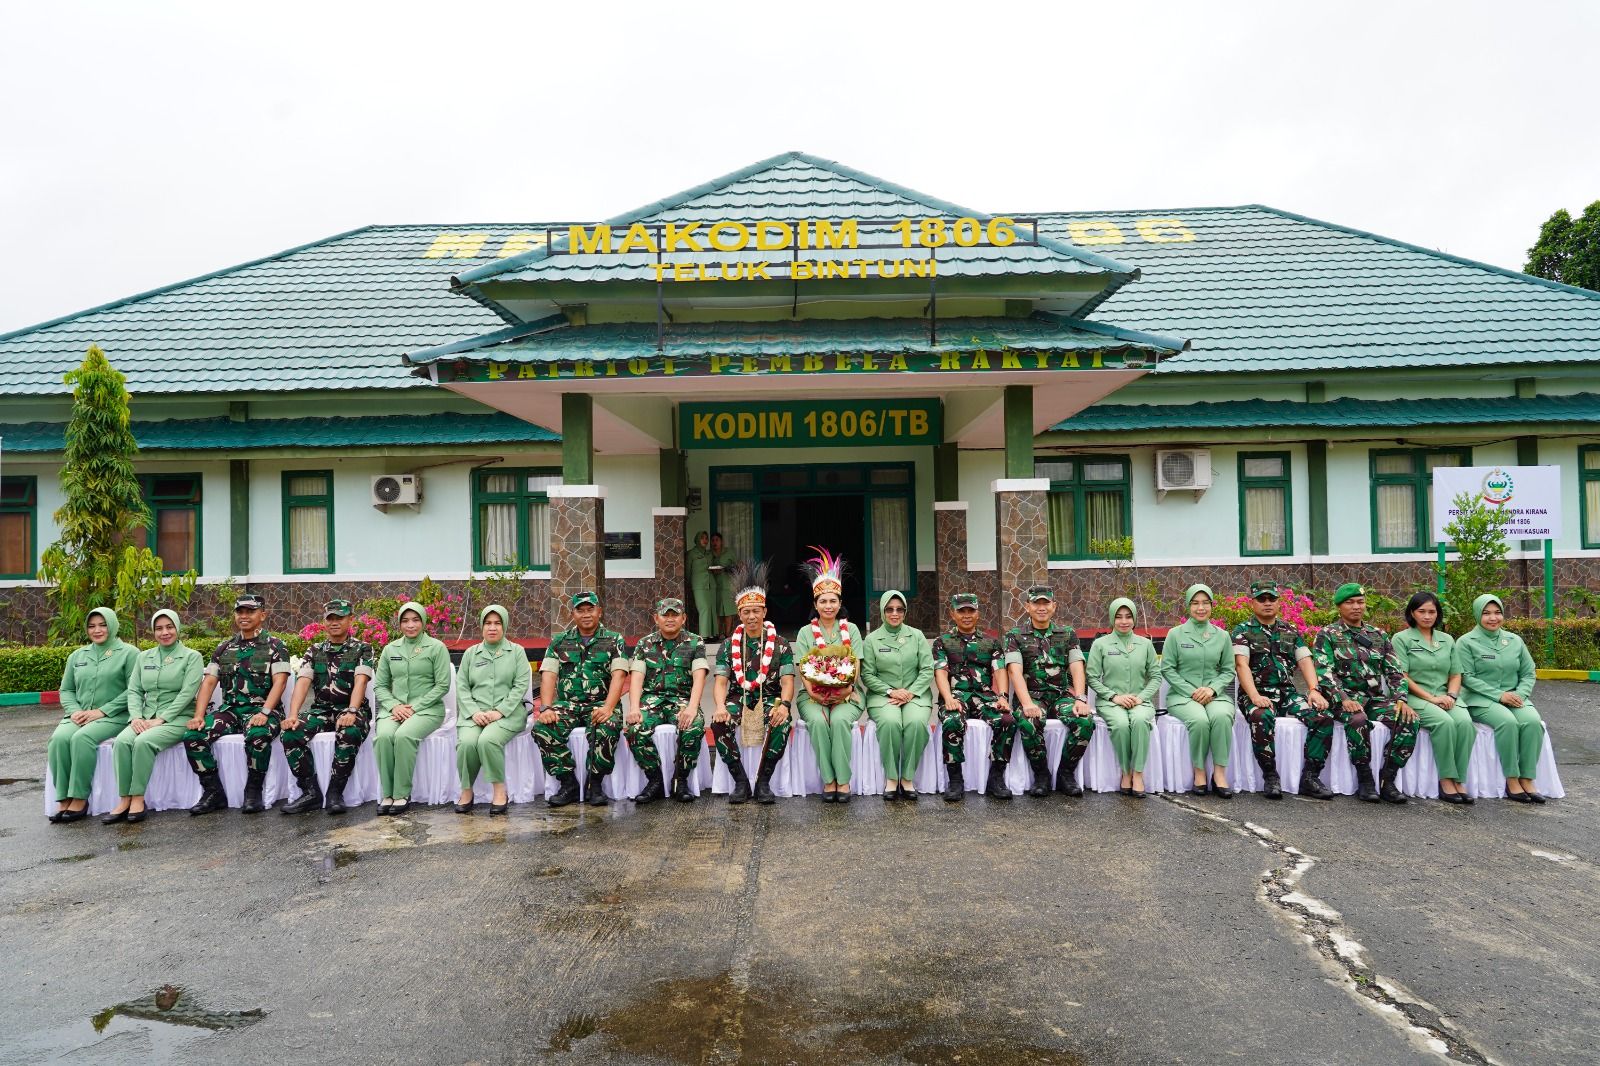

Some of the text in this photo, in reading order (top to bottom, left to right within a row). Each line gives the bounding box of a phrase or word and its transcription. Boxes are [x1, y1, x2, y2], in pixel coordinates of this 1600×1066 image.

[568, 220, 858, 255] MAKODIM
[891, 217, 1017, 248] 1806
[649, 259, 937, 283] TELUK BINTUNI
[709, 354, 908, 375] PEMBELA
[692, 409, 930, 440] KODIM 1806/TB
